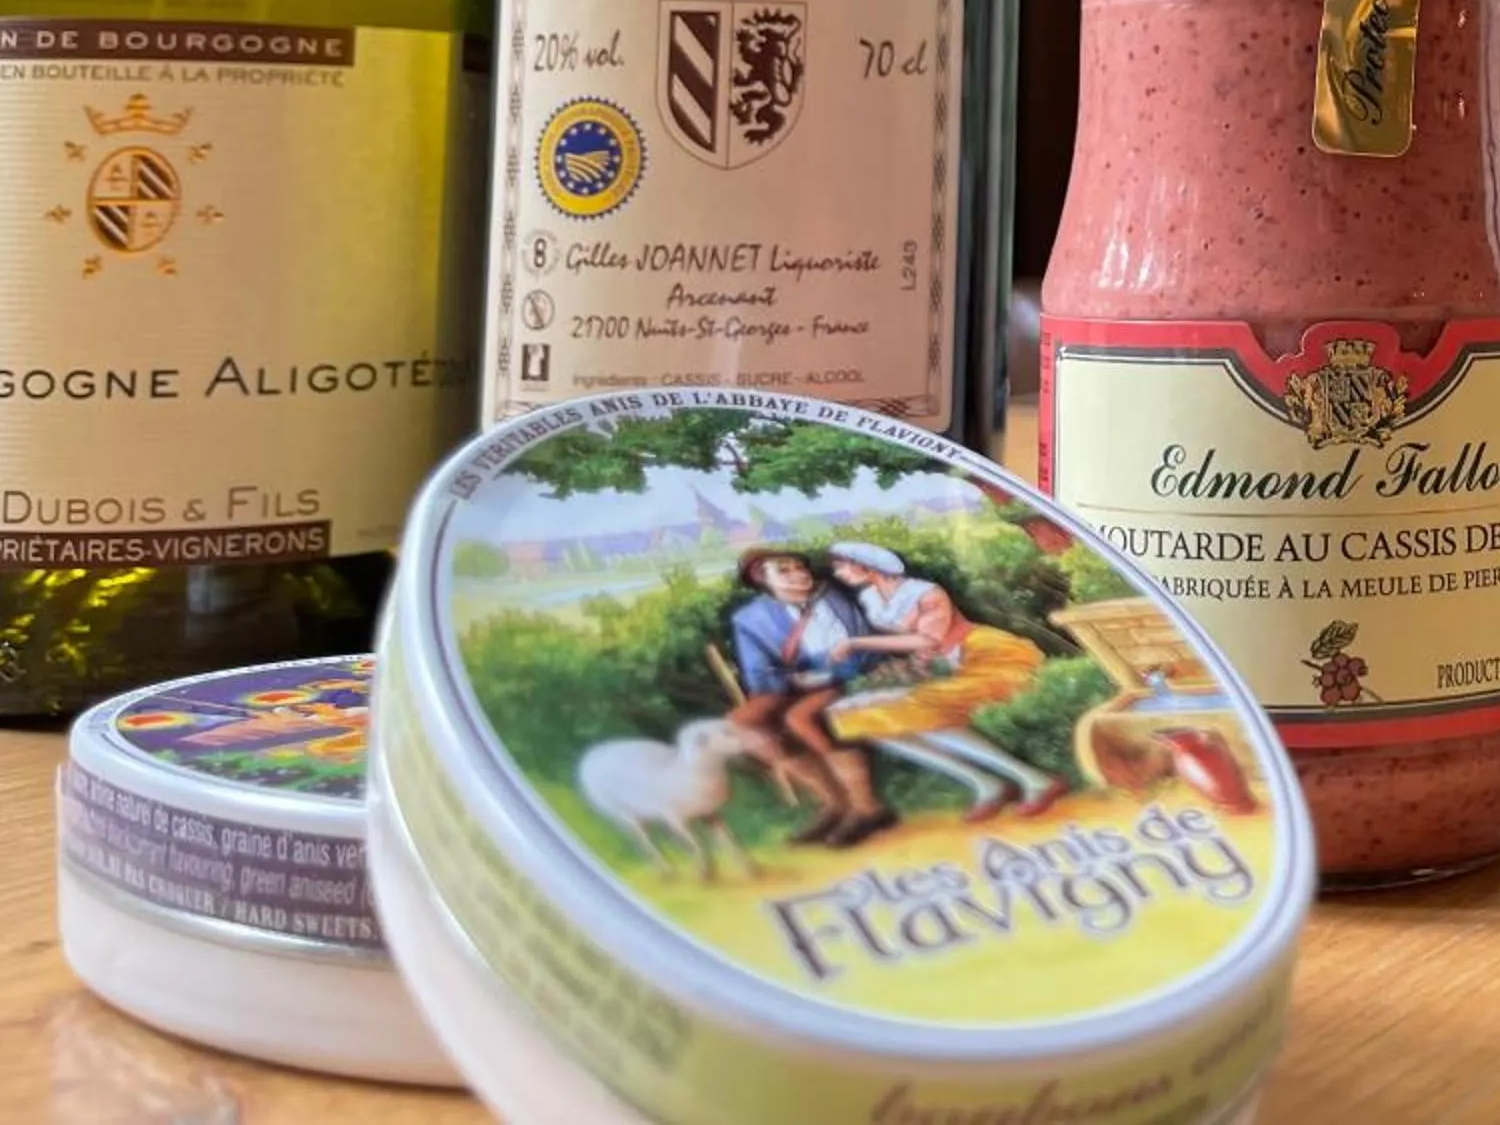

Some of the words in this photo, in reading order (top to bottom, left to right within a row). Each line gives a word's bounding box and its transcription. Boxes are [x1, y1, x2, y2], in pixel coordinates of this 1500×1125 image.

[37, 30, 79, 49] DE
[99, 30, 344, 58] BOURGOGNE
[533, 32, 580, 72] 20%
[858, 39, 893, 77] 70
[902, 38, 928, 75] cl
[32, 64, 152, 81] BOUTEILLE
[181, 67, 210, 83] LA
[217, 67, 345, 89] PROPRIÉTÉ
[565, 241, 630, 275] Gilles
[636, 243, 762, 273] JOANNET
[770, 243, 881, 282] Liquoriste
[667, 282, 778, 309] Arcenant
[571, 314, 631, 340] 21700
[635, 315, 791, 346] Nuits-St-Georges
[813, 314, 871, 339] France
[589, 393, 644, 418] ANIS
[651, 392, 683, 407] DE
[693, 390, 810, 415] L'ABBAYE
[817, 405, 850, 424] DE
[856, 416, 963, 460] FLAVIGNY
[1149, 443, 1363, 500] Edmond
[182, 496, 207, 522] &
[0, 527, 325, 563] RIÉTAIRES-VIGNERONS
[1100, 525, 1266, 562] OUTARDE
[1274, 531, 1332, 562] AU
[1341, 528, 1456, 561] CASSIS
[1153, 574, 1272, 601] ABRIQUÉE
[1278, 573, 1296, 599] À
[1303, 580, 1333, 598] LA
[1340, 576, 1422, 599] MEULE
[1430, 573, 1458, 594] DE
[1437, 657, 1500, 689] PRODUCT
[221, 824, 273, 859] graine
[276, 828, 331, 868] d'anis
[335, 842, 366, 868] ver
[981, 824, 1132, 885] Anis
[1138, 804, 1216, 844] de
[234, 900, 288, 931] HARD
[769, 836, 1255, 980] Flavigny
